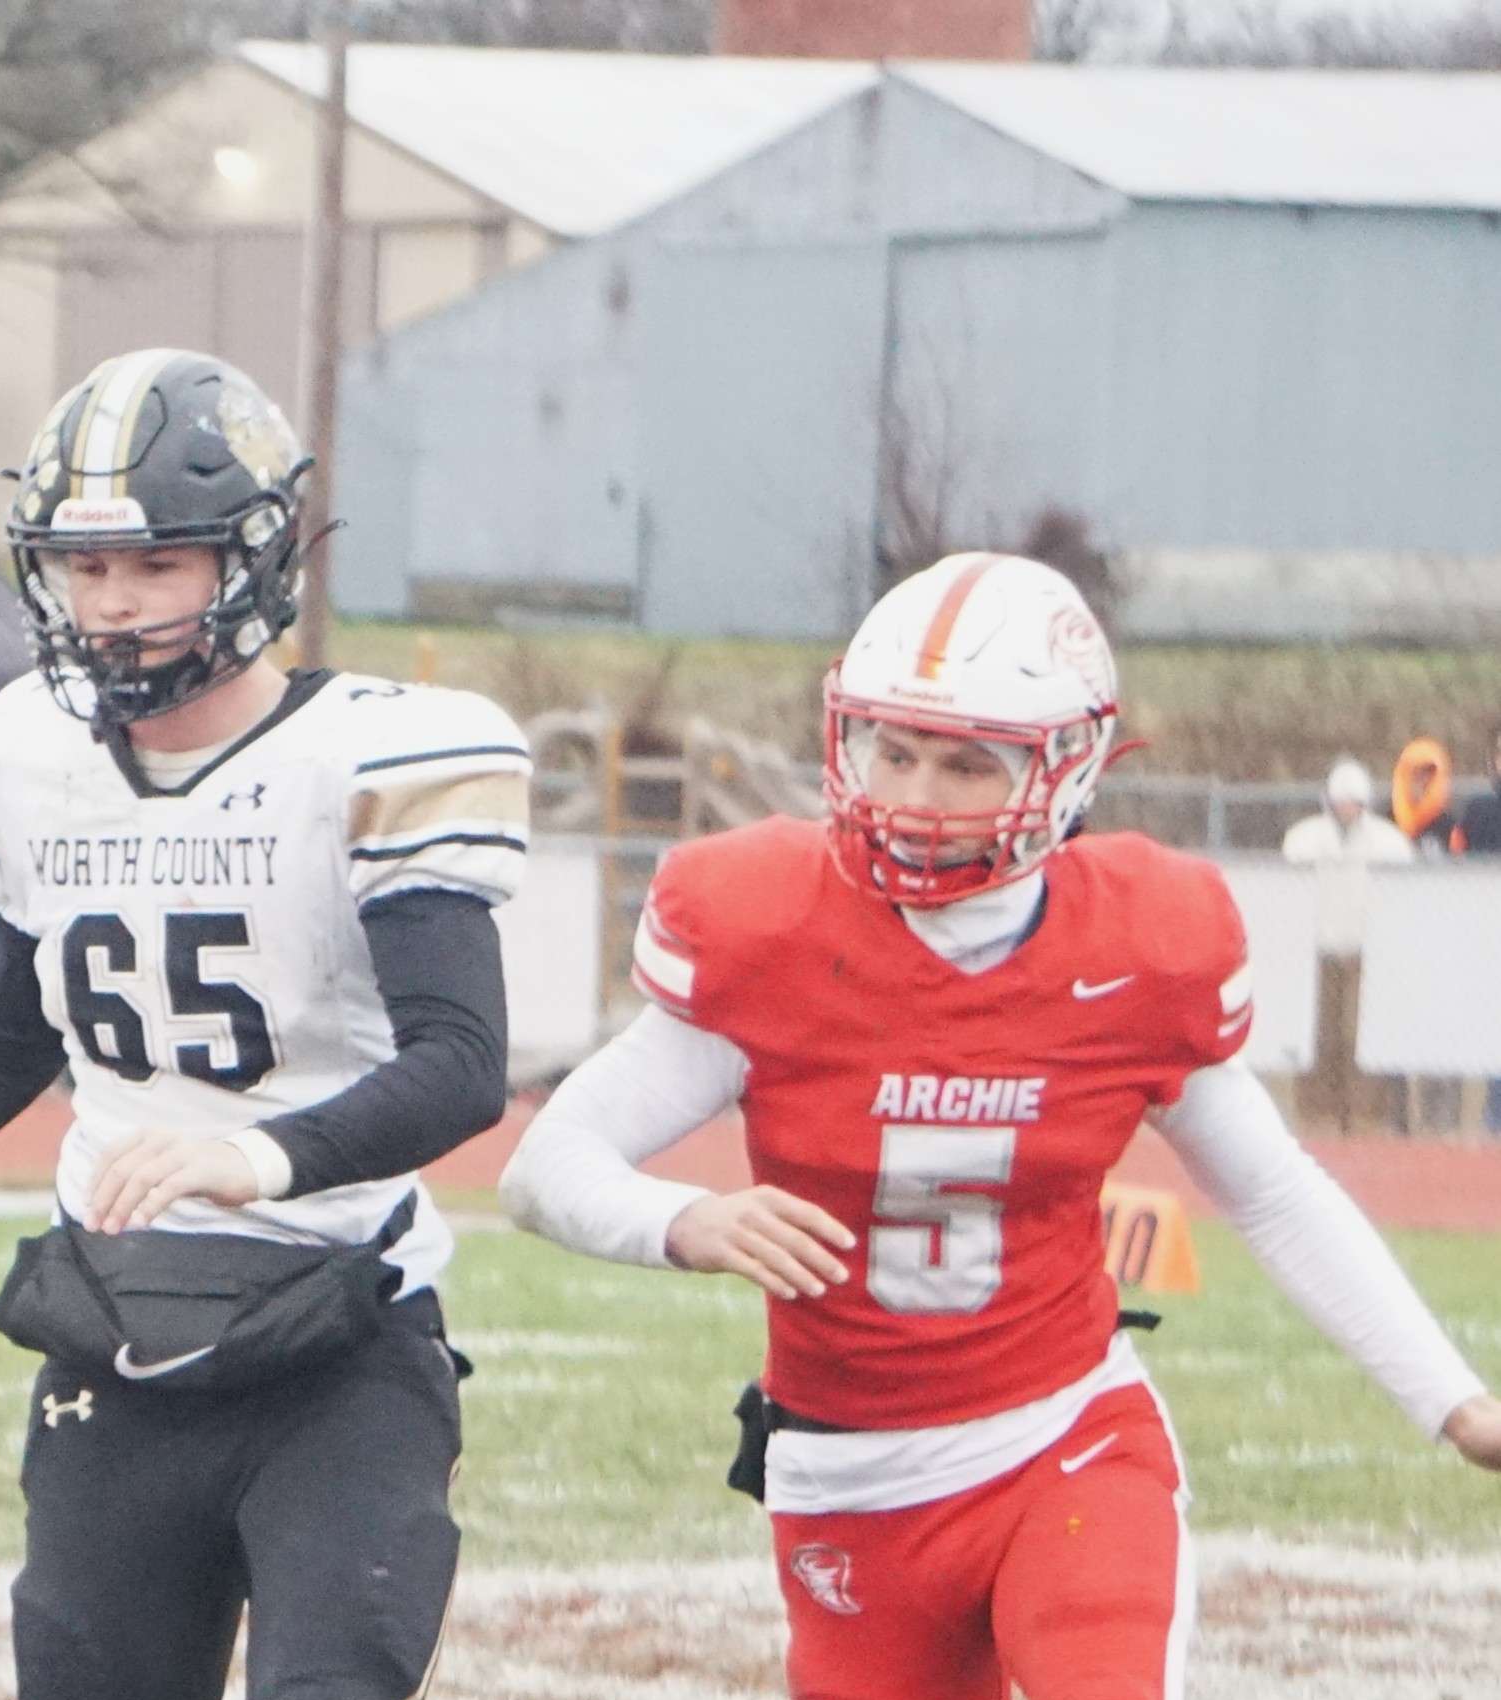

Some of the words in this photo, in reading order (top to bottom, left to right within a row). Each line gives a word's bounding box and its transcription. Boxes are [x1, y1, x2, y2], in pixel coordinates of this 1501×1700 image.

[151, 836, 278, 886] COUNTY
[59, 908, 280, 1093] 65
[869, 1073, 1047, 1122] ARCHIE
[865, 1122, 1018, 1315] 5
